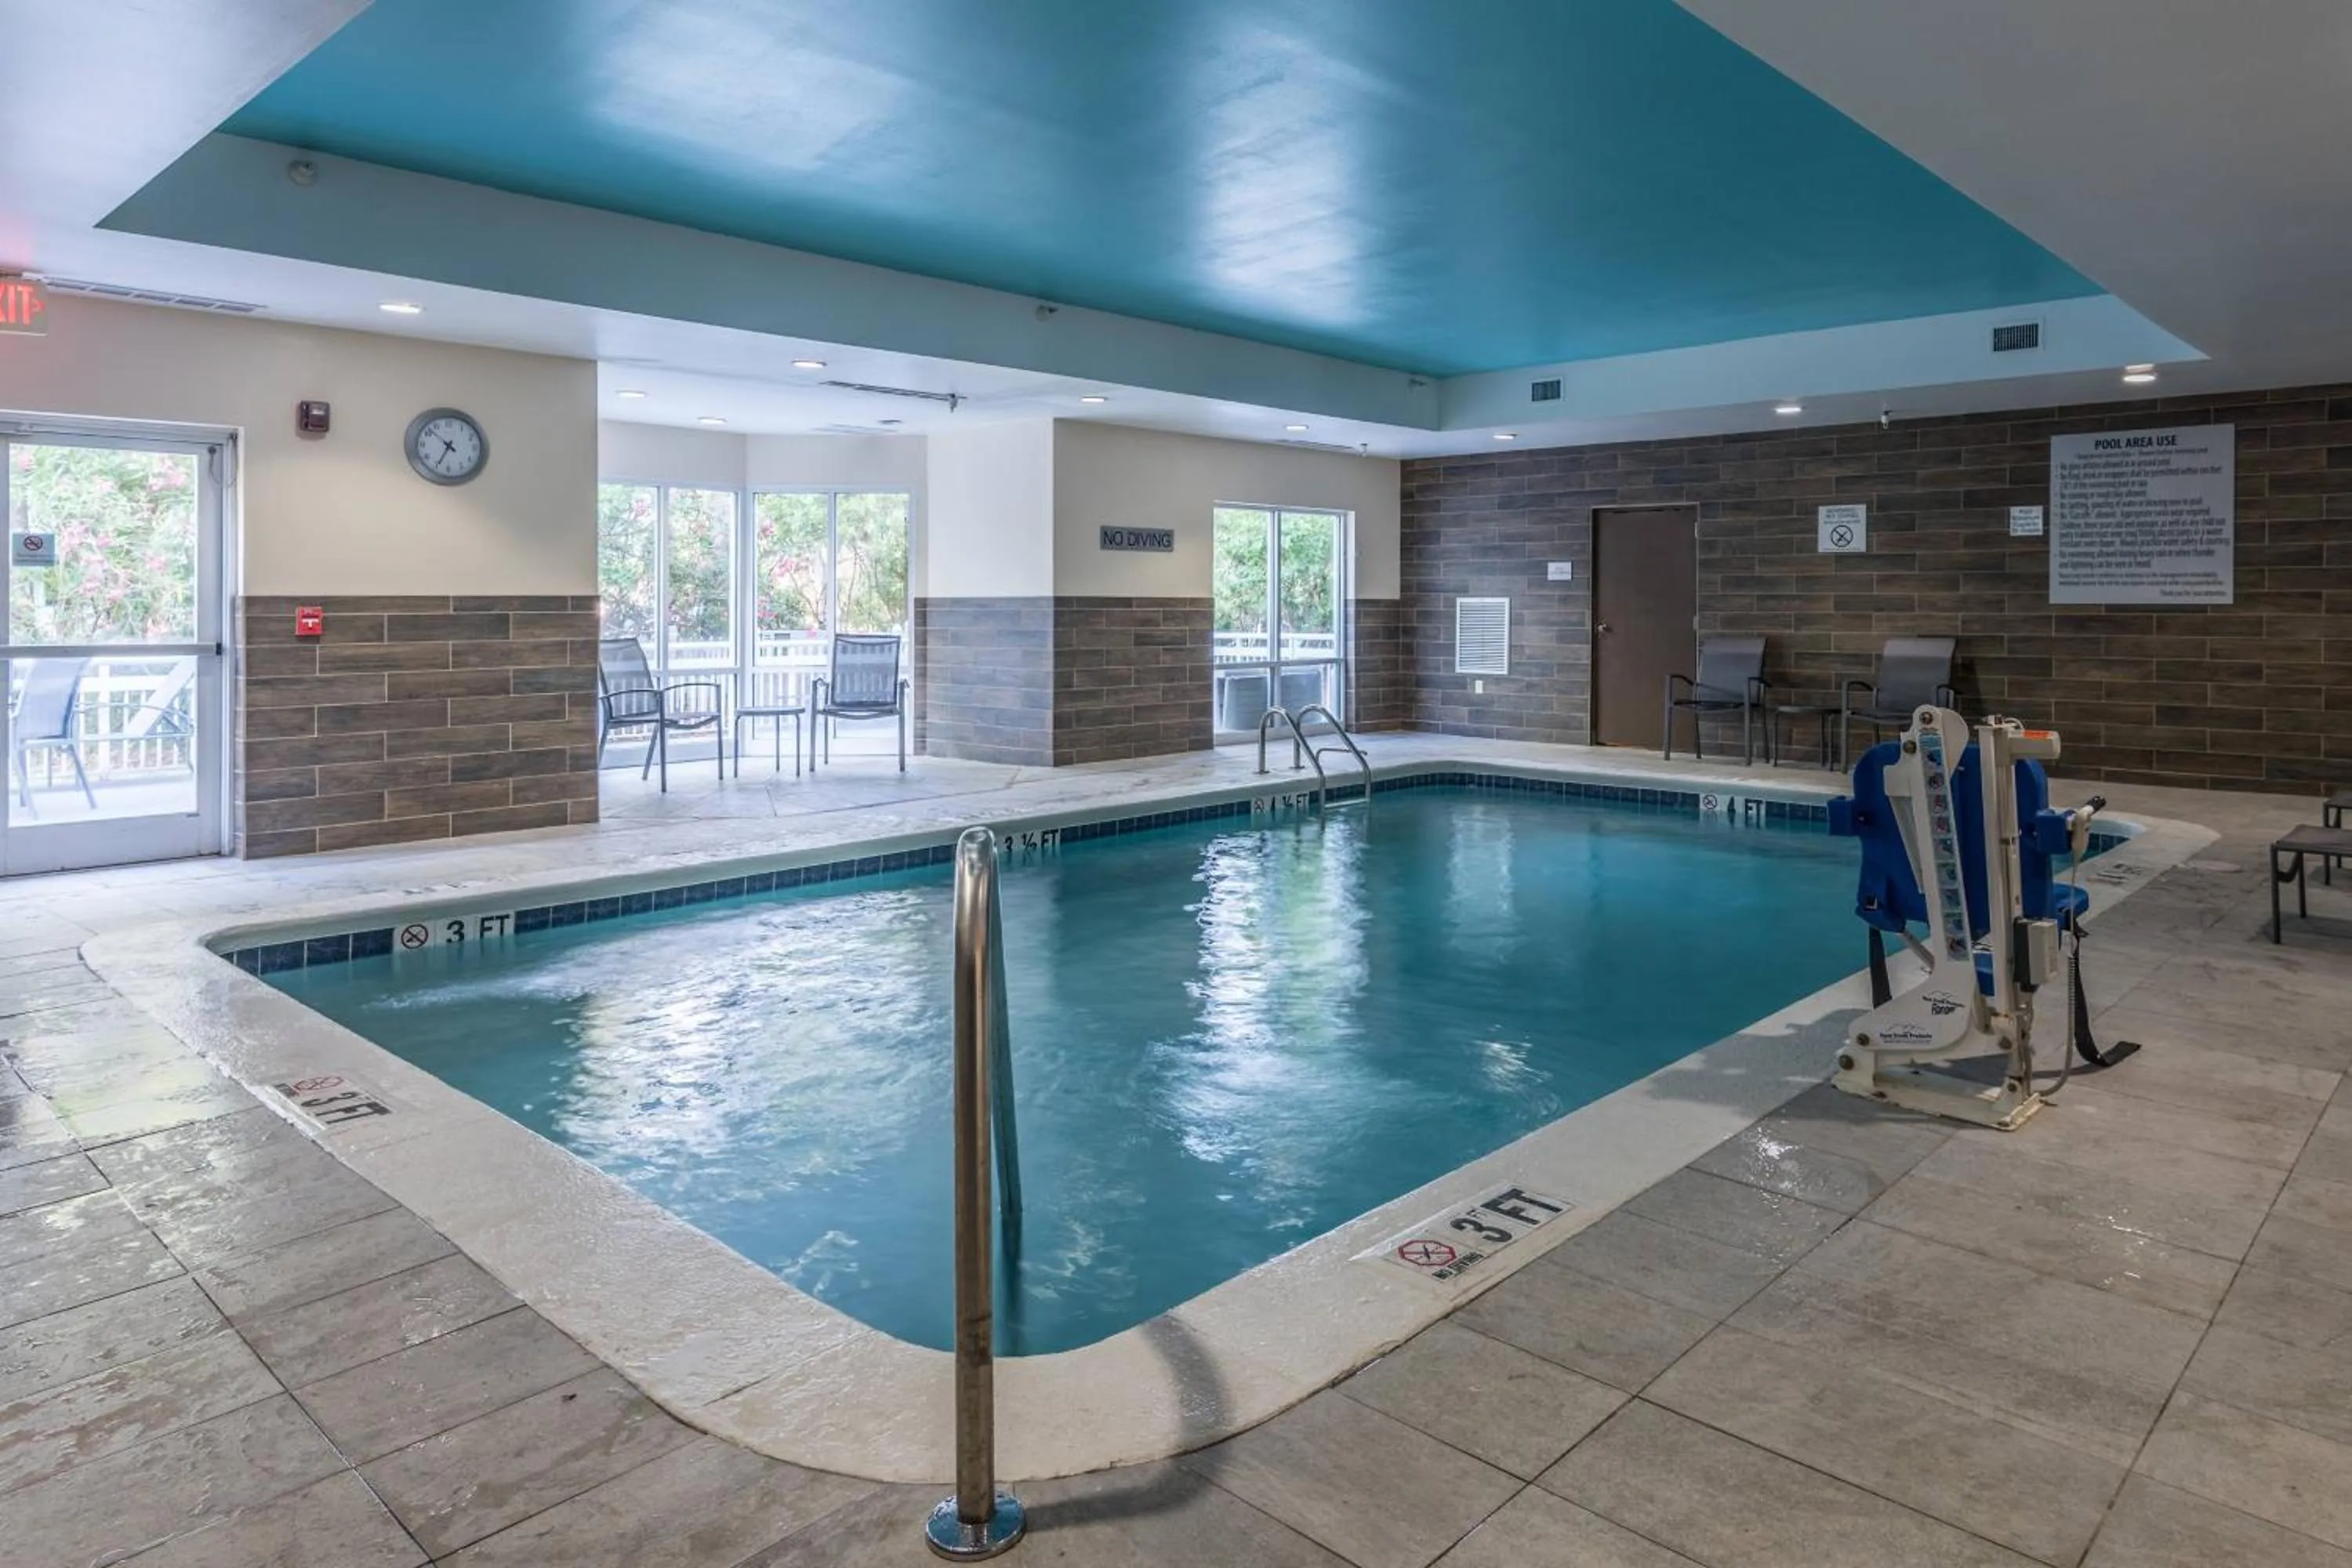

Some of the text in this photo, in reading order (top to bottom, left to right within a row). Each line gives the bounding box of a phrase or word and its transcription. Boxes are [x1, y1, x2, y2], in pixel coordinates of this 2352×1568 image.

[2095, 435, 2177, 450] POOL AREA USE
[1103, 531, 1171, 547] NO DIVING
[1744, 798, 1763, 815] FT
[1004, 836, 1014, 853] 3
[1040, 829, 1059, 848] FT
[446, 914, 511, 943] 3 FT
[301, 1091, 393, 1124] 3 FT
[1450, 1188, 1563, 1243] 3 FT
